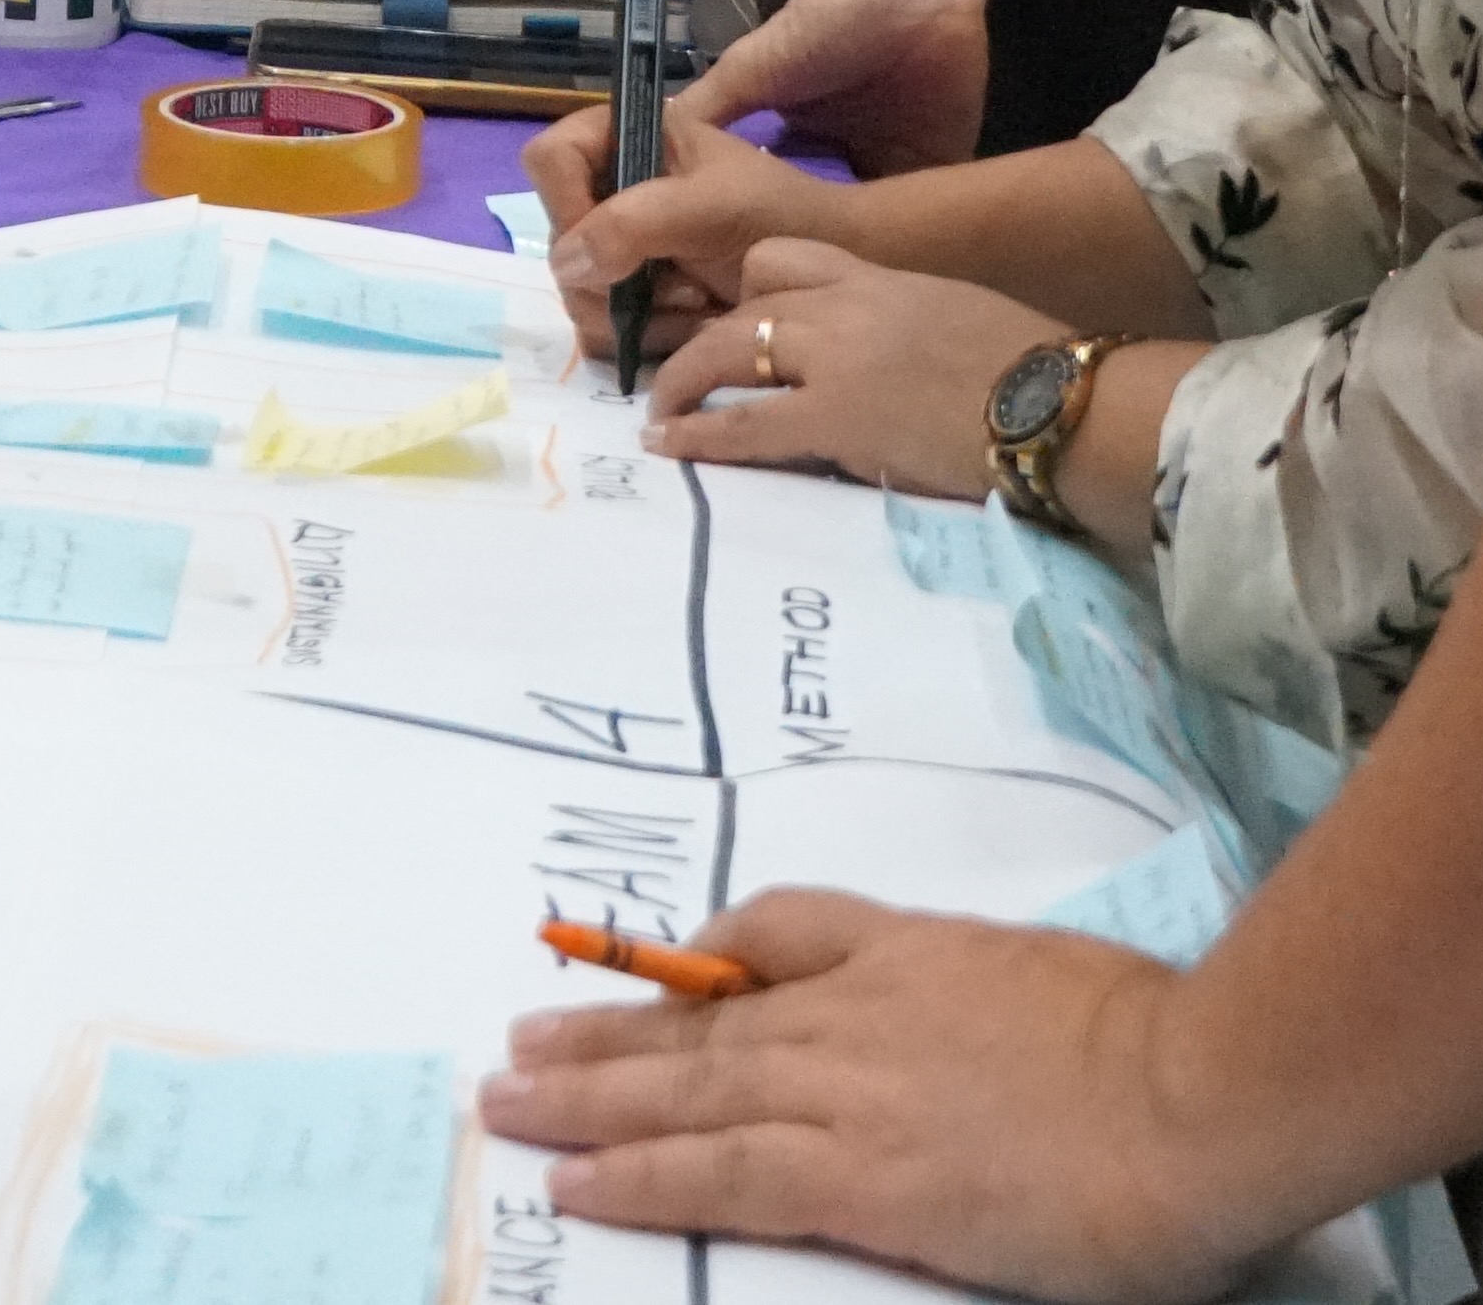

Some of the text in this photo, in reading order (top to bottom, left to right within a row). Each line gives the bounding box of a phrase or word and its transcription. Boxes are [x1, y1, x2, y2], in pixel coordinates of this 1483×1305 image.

[194, 93, 224, 118] BEST
[230, 91, 258, 115] BUY
[779, 586, 851, 767] METHOD
[525, 691, 684, 753] 4
